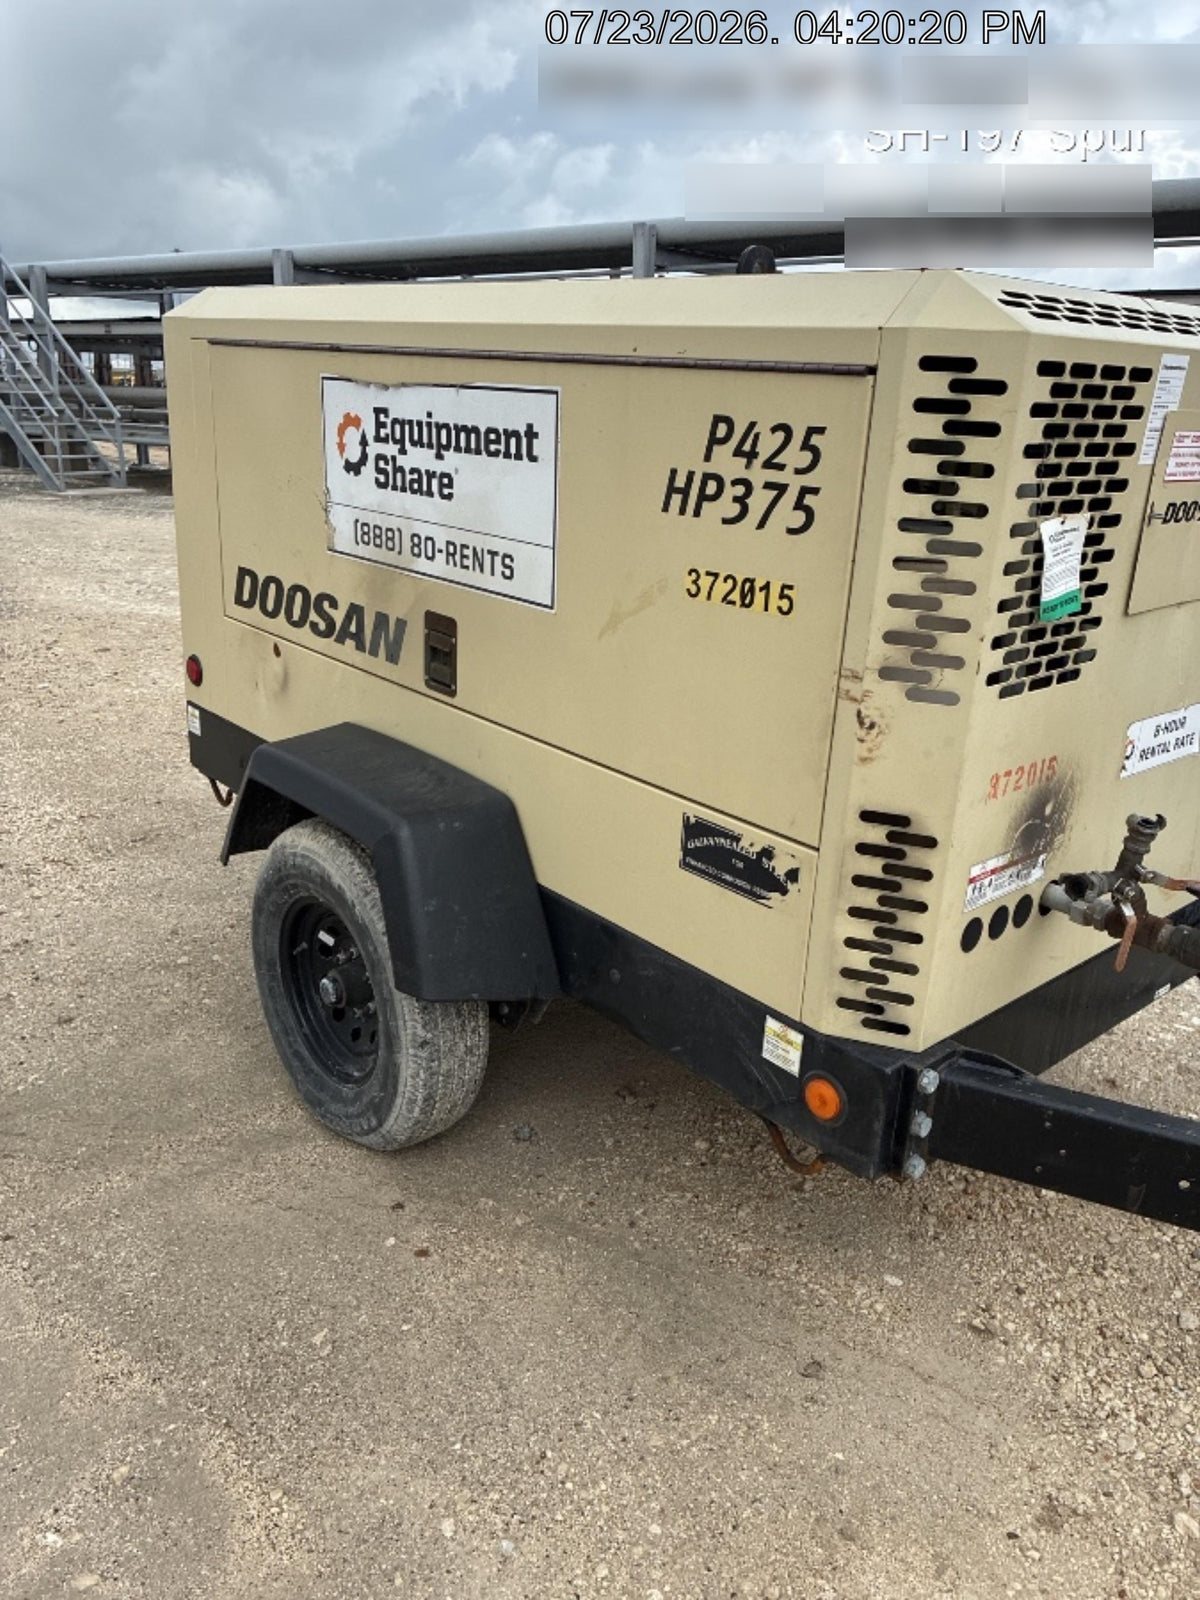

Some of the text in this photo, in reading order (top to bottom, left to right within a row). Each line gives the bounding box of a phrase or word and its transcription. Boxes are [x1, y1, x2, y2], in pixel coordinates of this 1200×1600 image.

[373, 406, 539, 463] Equipment
[703, 414, 827, 475] P425
[374, 453, 454, 501] Share
[661, 467, 822, 536] HP375
[353, 518, 515, 581] (888) 80-RENTS
[233, 565, 408, 666] DOOSAN
[1139, 731, 1196, 762] RENTAL RATE
